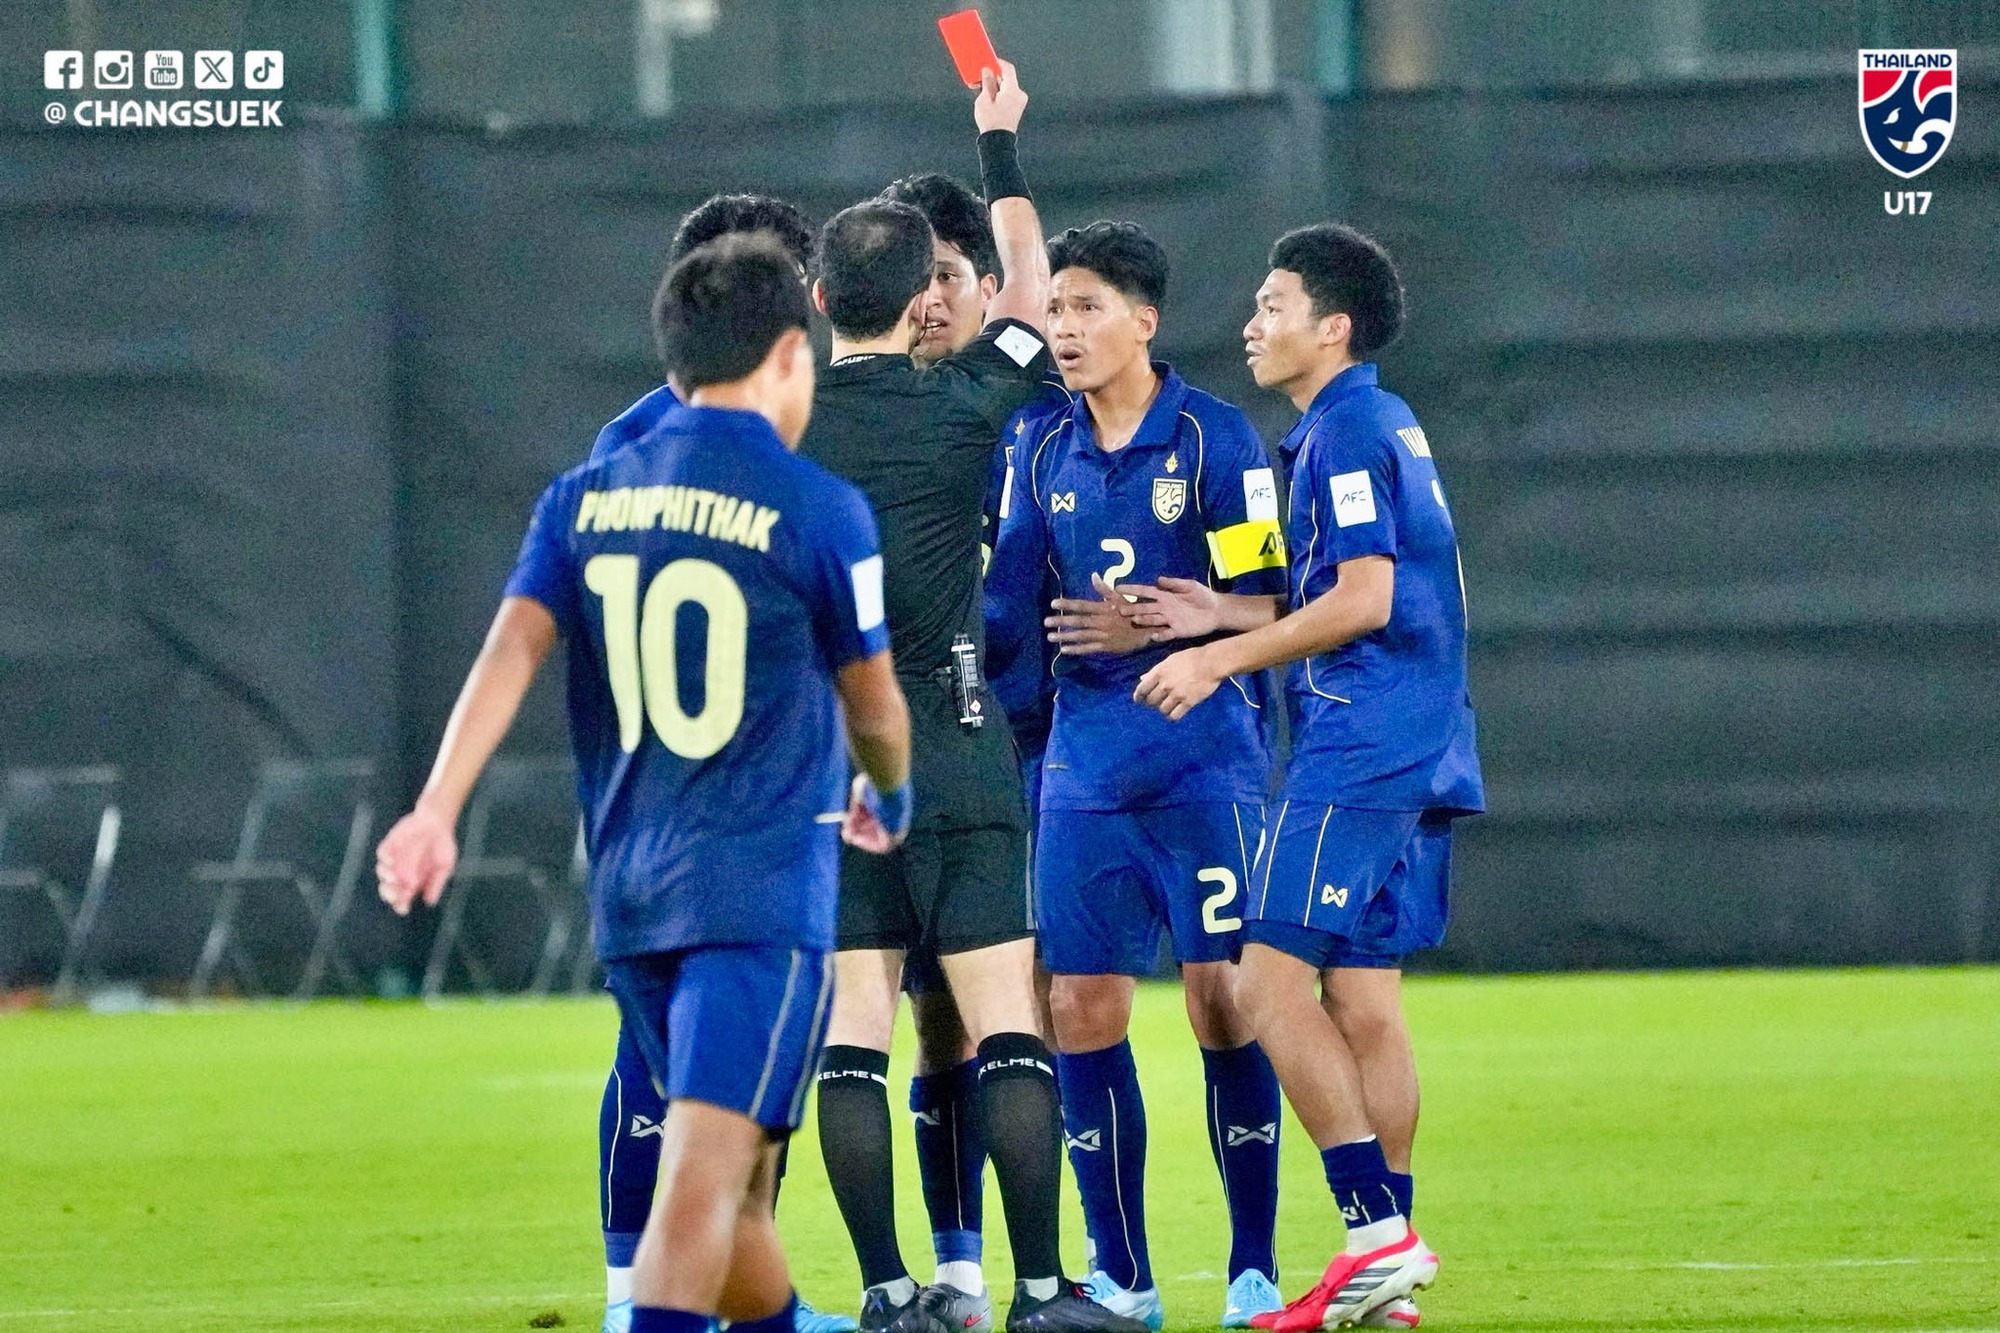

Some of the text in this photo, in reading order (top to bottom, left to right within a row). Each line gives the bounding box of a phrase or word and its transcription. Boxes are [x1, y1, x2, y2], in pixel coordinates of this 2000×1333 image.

[575, 484, 781, 553] PHONPHITHAK
[584, 552, 748, 760] 10
[1197, 866, 1242, 934] 2
[978, 1057, 1035, 1079] KELME
